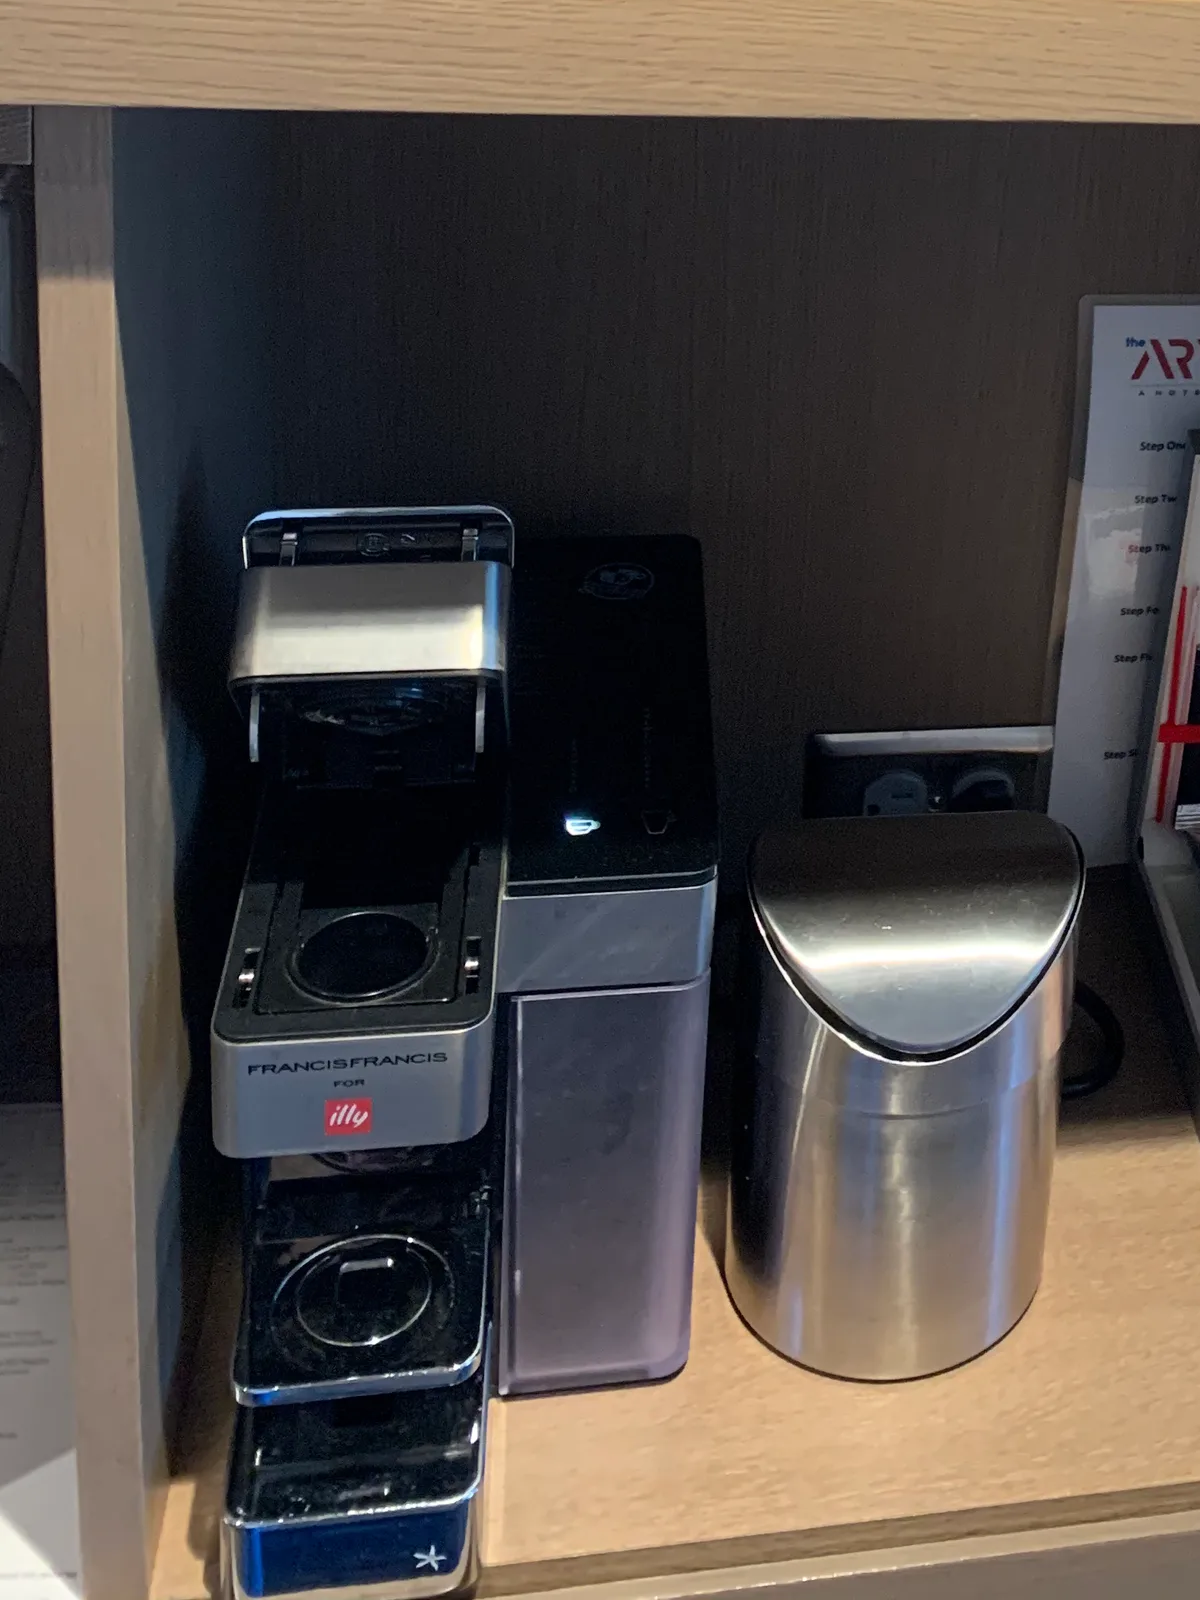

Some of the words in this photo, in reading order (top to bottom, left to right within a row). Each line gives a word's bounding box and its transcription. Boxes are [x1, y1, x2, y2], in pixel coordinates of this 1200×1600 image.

[1126, 337, 1146, 347] the
[1140, 441, 1164, 452] Step
[1134, 494, 1158, 505] Step
[1128, 543, 1152, 554] Step
[1120, 607, 1144, 617] Step
[1114, 654, 1138, 664] Step
[1103, 751, 1126, 760] Step
[333, 1078, 365, 1088] FOR
[329, 1103, 369, 1128] illy
